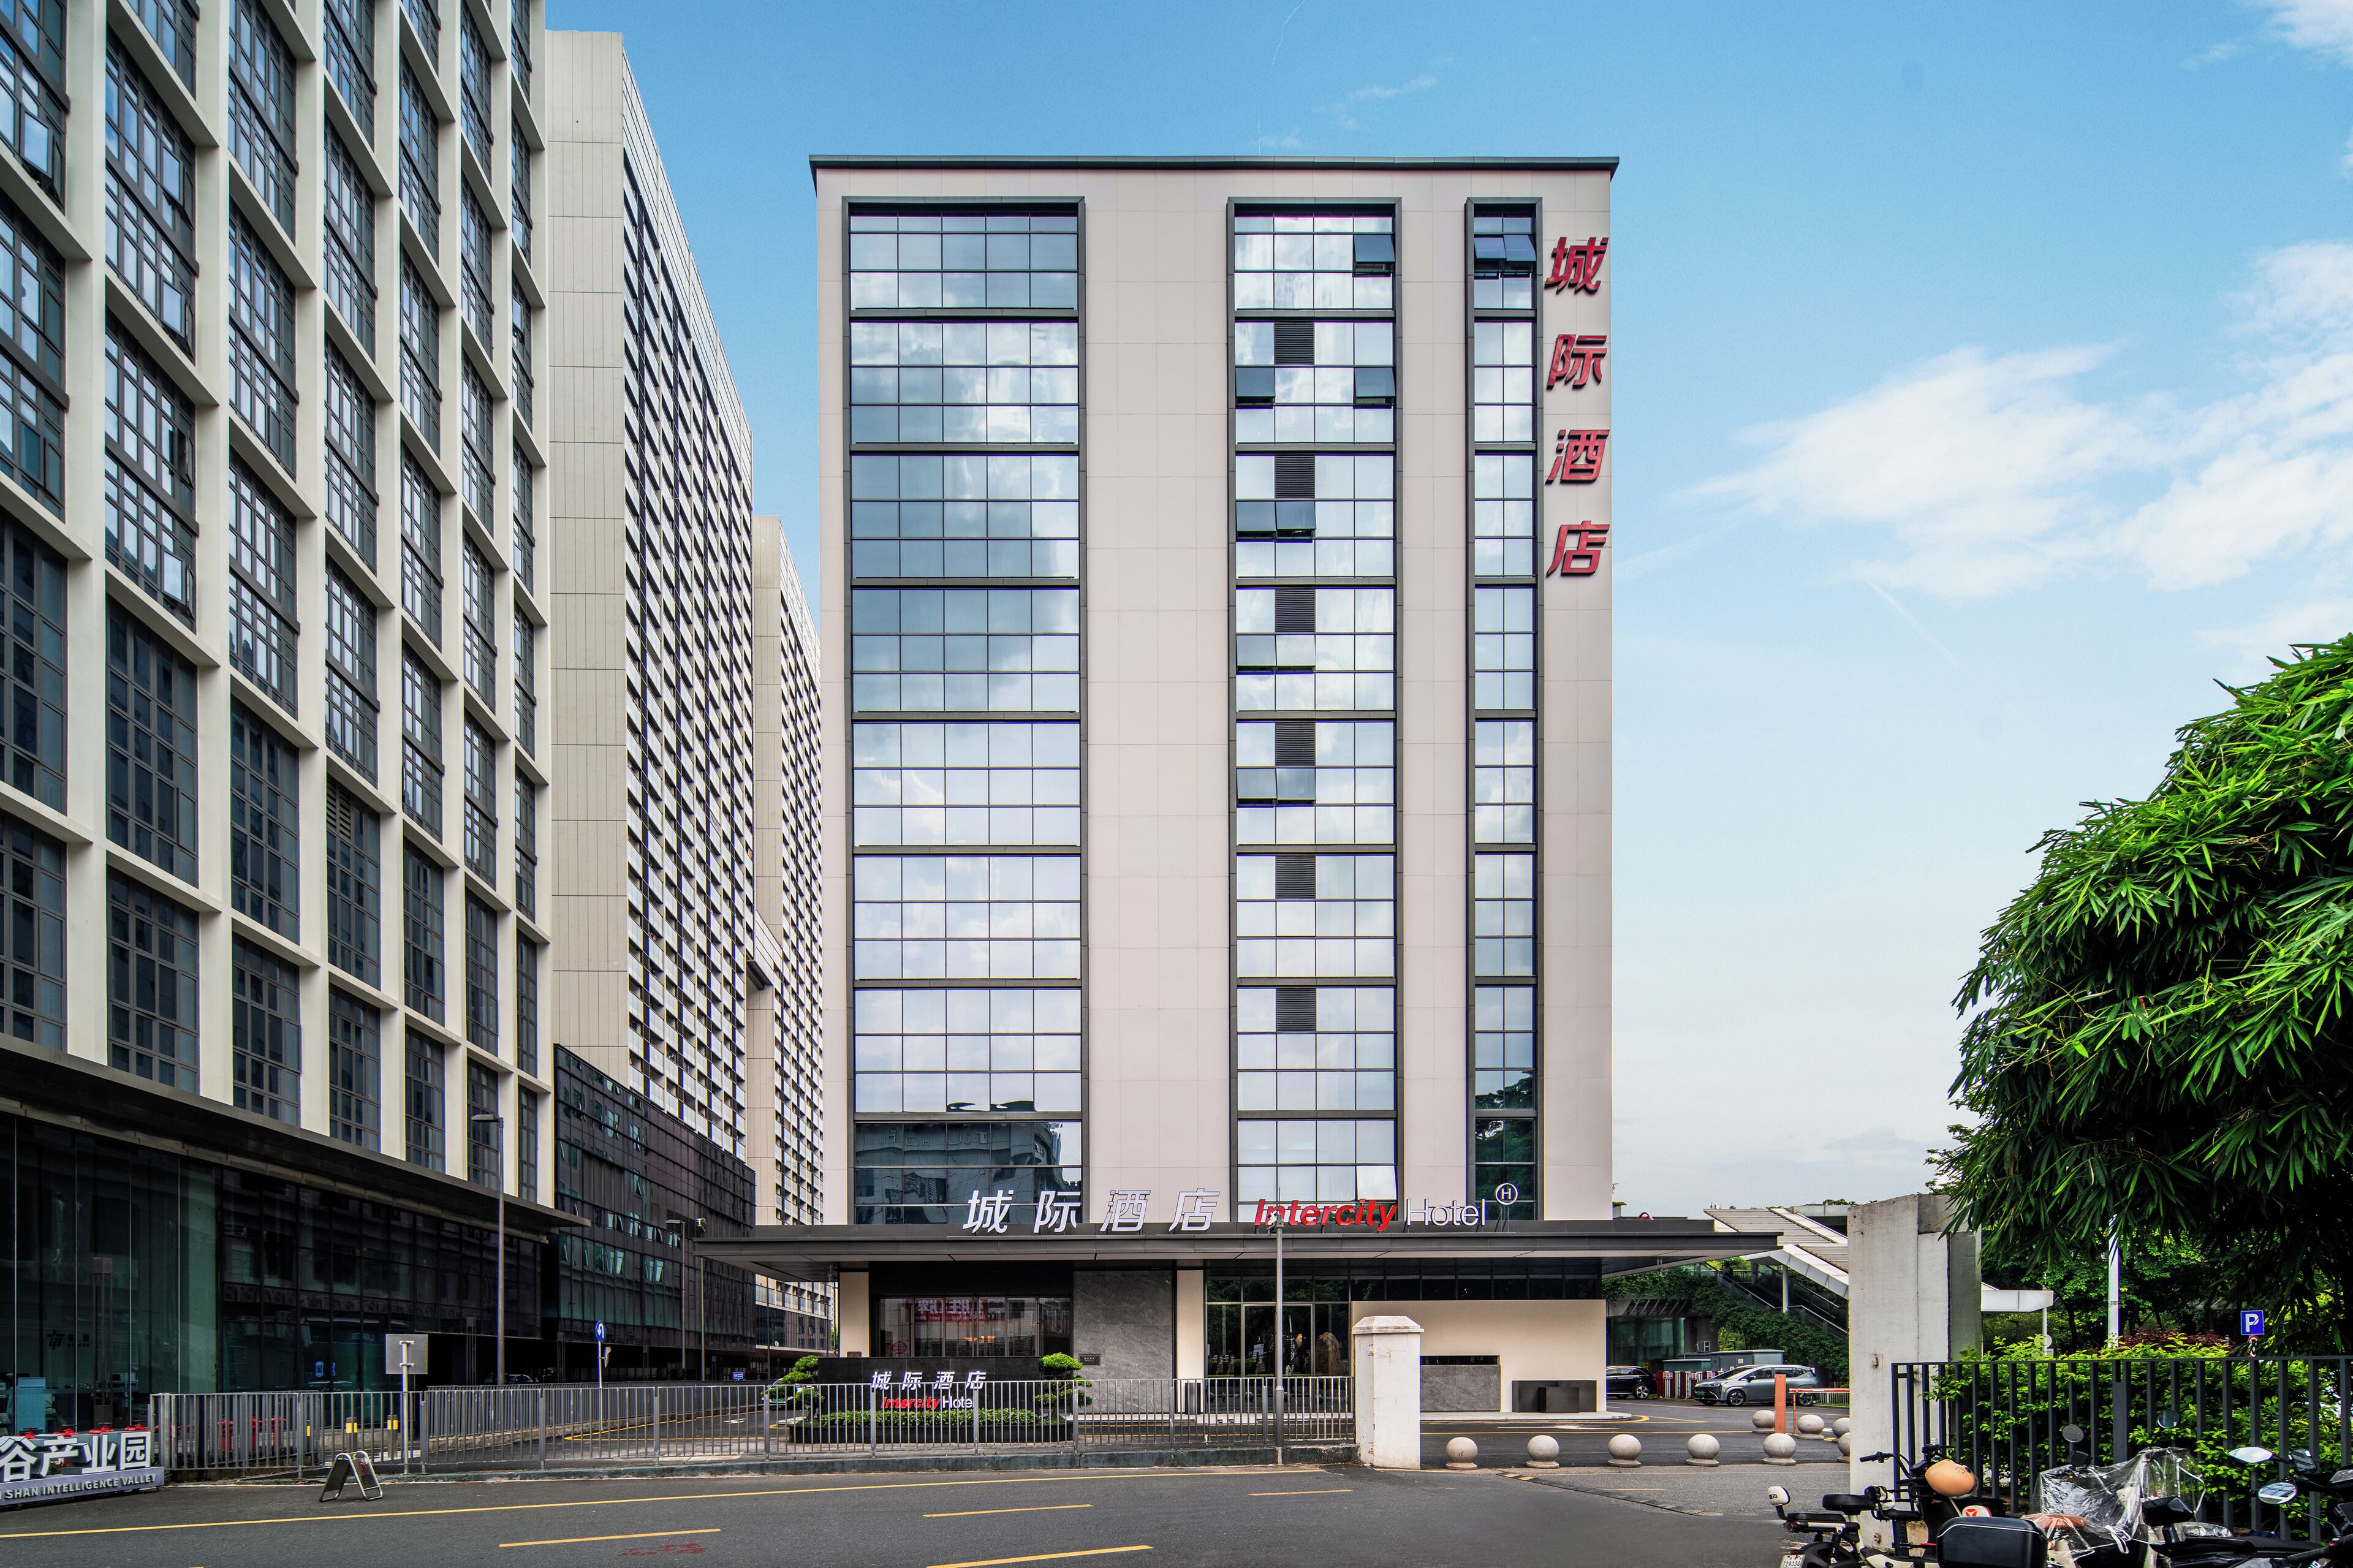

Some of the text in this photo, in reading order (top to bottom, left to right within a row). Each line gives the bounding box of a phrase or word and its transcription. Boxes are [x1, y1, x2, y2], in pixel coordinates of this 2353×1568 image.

[1544, 237, 1610, 578] 城际酒店
[963, 1188, 1220, 1233] 城际酒店
[1254, 1199, 1485, 1232] Intercity Hotel
[2245, 1313, 2259, 1332] P
[871, 1371, 987, 1390] 城际酒店
[881, 1396, 941, 1410] Intercity
[0, 1431, 151, 1482] 谷产业园
[4, 1487, 39, 1500] SHAN
[42, 1477, 119, 1495] INTELLIGENCE
[122, 1474, 157, 1486] VALLEY
